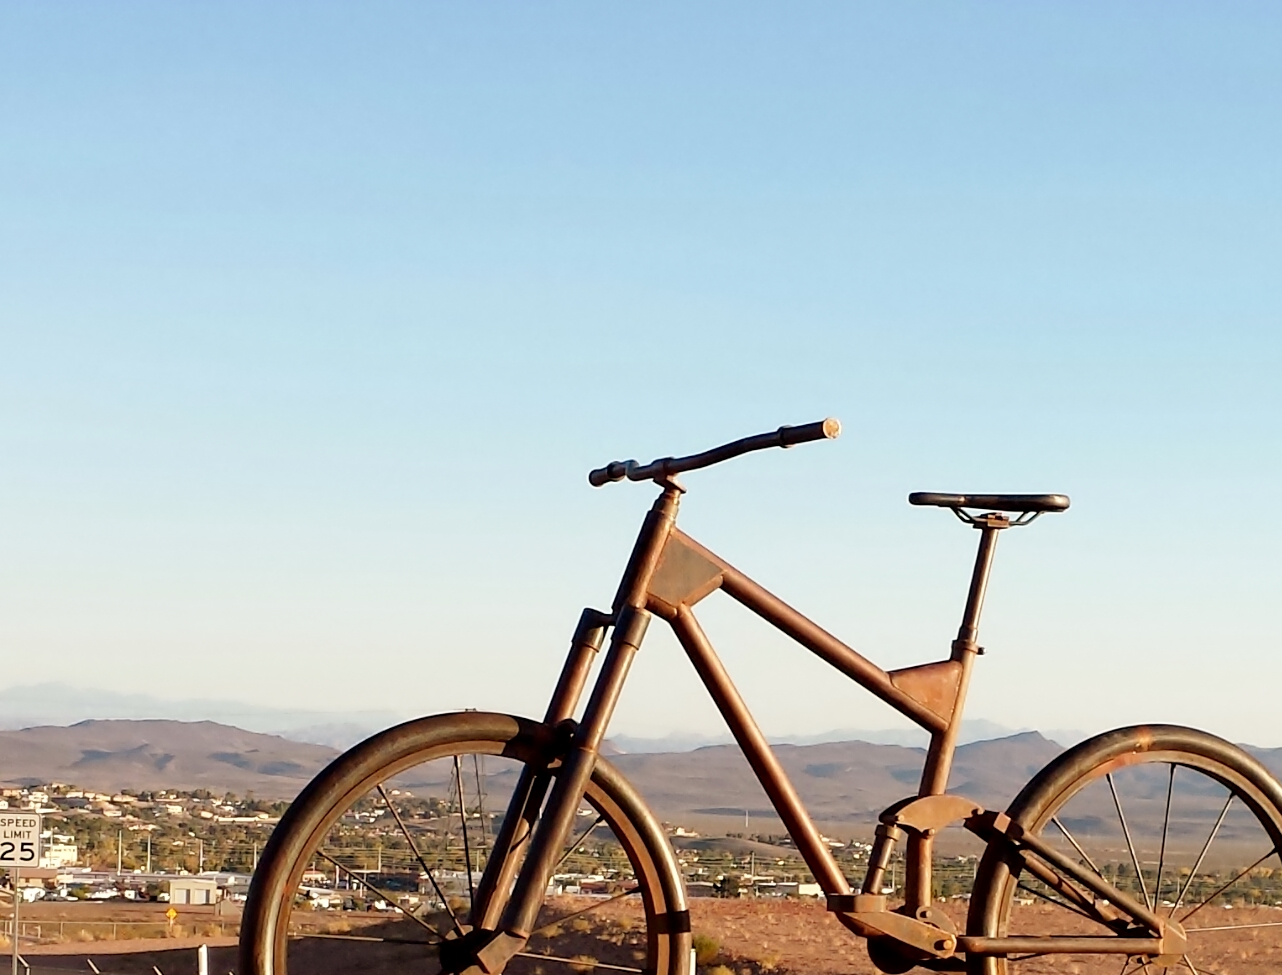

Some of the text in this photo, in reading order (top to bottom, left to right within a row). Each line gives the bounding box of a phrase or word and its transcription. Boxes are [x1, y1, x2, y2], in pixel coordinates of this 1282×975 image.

[0, 818, 37, 828] SPEED
[3, 830, 31, 839] LIMIT
[0, 842, 35, 861] 25
